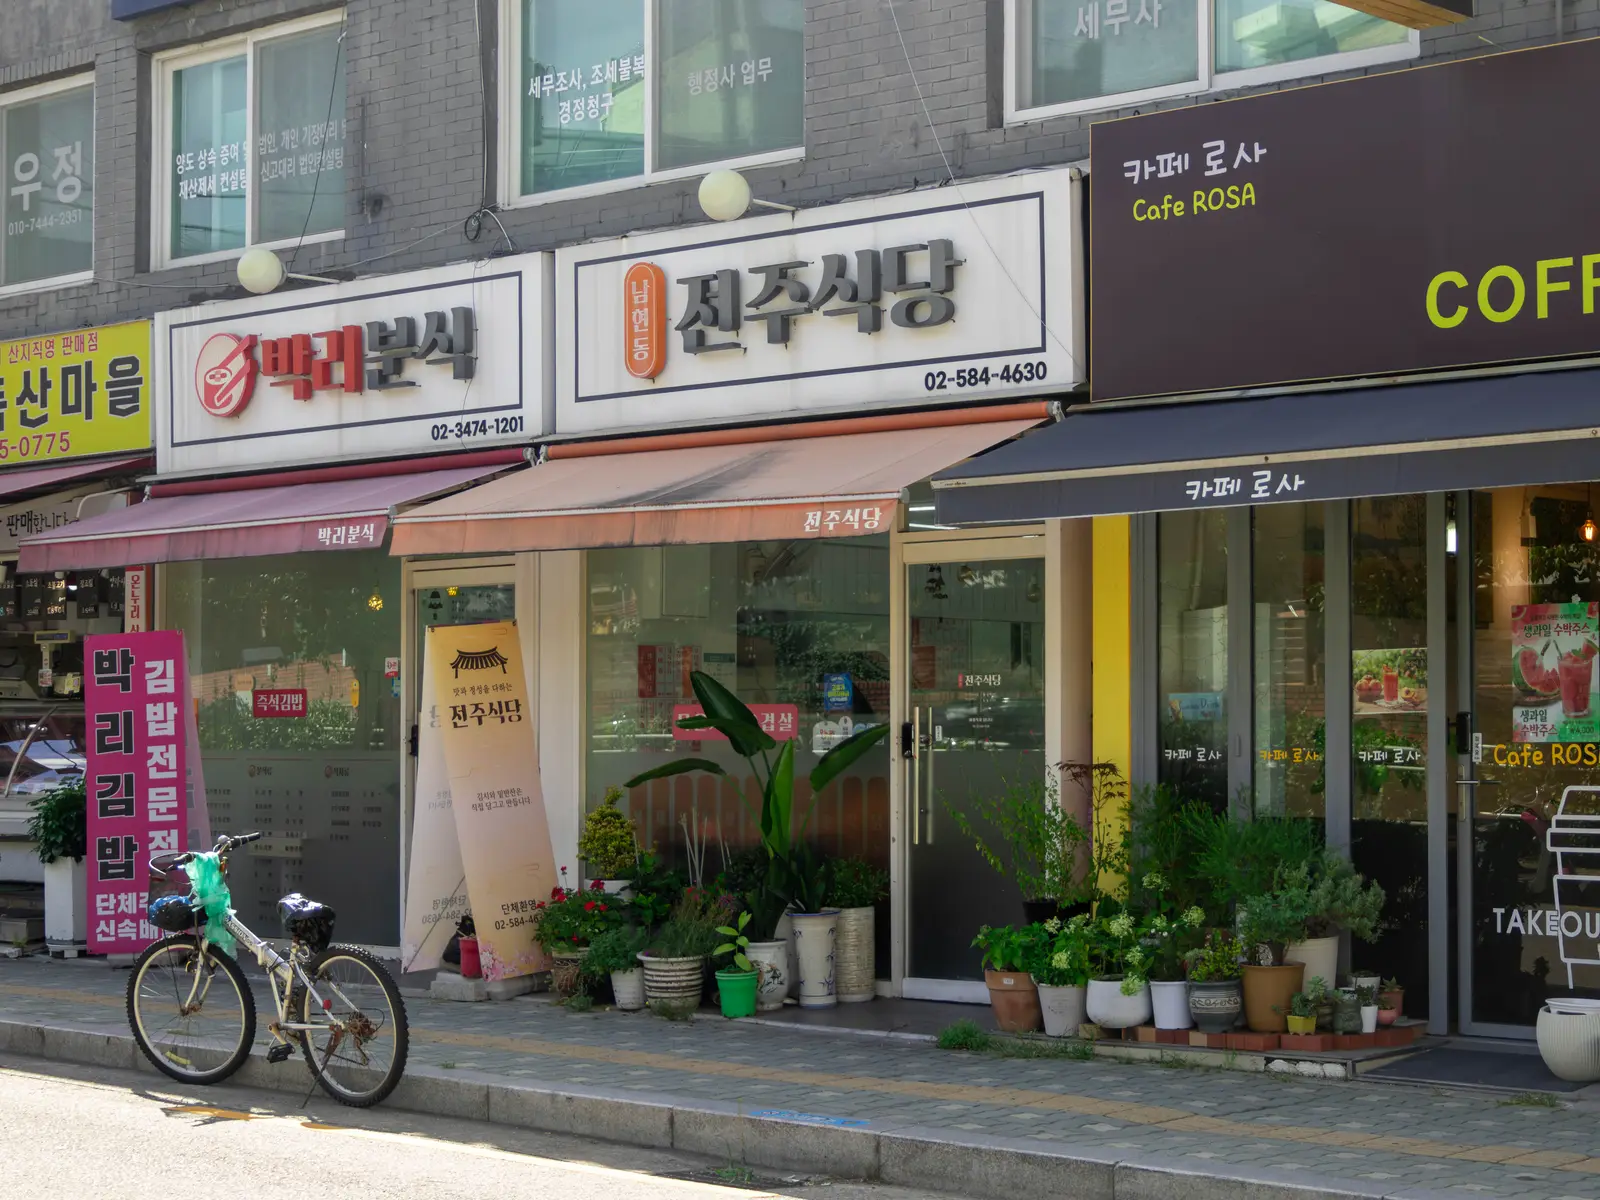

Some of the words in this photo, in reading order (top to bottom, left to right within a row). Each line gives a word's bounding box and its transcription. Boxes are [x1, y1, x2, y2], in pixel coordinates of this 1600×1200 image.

[1074, 0, 1162, 39] 세무사
[590, 54, 645, 86] 조세불복
[741, 57, 773, 86] 업무
[558, 92, 615, 125] 경정청구
[281, 126, 299, 150] 개인
[302, 119, 337, 146] 기장대리
[176, 152, 195, 175] 양도
[198, 147, 216, 171] 상속
[220, 141, 239, 166] 증여
[261, 155, 296, 182] 신고대리
[1123, 152, 1189, 184] 카페
[1202, 139, 1267, 176] 로사
[11, 141, 83, 211] 우정
[179, 174, 217, 200] 재산제세
[1133, 194, 1185, 221] Cafe
[1193, 182, 1256, 215] ROSA
[674, 238, 964, 356] 전주식당
[631, 279, 649, 361] 남현동
[8, 338, 55, 364] 산지직영
[62, 331, 98, 356] 판매점
[260, 306, 478, 402] 박리분식
[924, 361, 1047, 391] 02-584-4630
[431, 416, 524, 441] 02-3474-1201
[1185, 477, 1241, 500] 카페
[1251, 470, 1305, 498] 로사
[318, 523, 374, 545] 박리분식
[803, 506, 882, 534] 전주식당
[1523, 623, 1552, 638] 생과일
[1553, 622, 1591, 637] 수박주스
[965, 674, 1001, 687] 전주식당
[256, 693, 304, 712] 즉석김밥
[449, 699, 523, 728] 전주식당
[1520, 708, 1548, 722] 생과일
[754, 712, 794, 732] 겹살
[1520, 723, 1558, 738] 수박주스
[1164, 748, 1192, 760] 카페
[1196, 747, 1222, 762] 로사
[1259, 749, 1287, 761] 카페
[1292, 747, 1320, 763] 로사
[1358, 750, 1387, 762] 카페
[1393, 748, 1421, 763] 로사
[1493, 743, 1544, 767] Cafe
[1551, 743, 1600, 766] ROS
[501, 899, 537, 916] 단체환영
[96, 919, 164, 942] 신속배
[1492, 907, 1600, 939] TAKEOU
